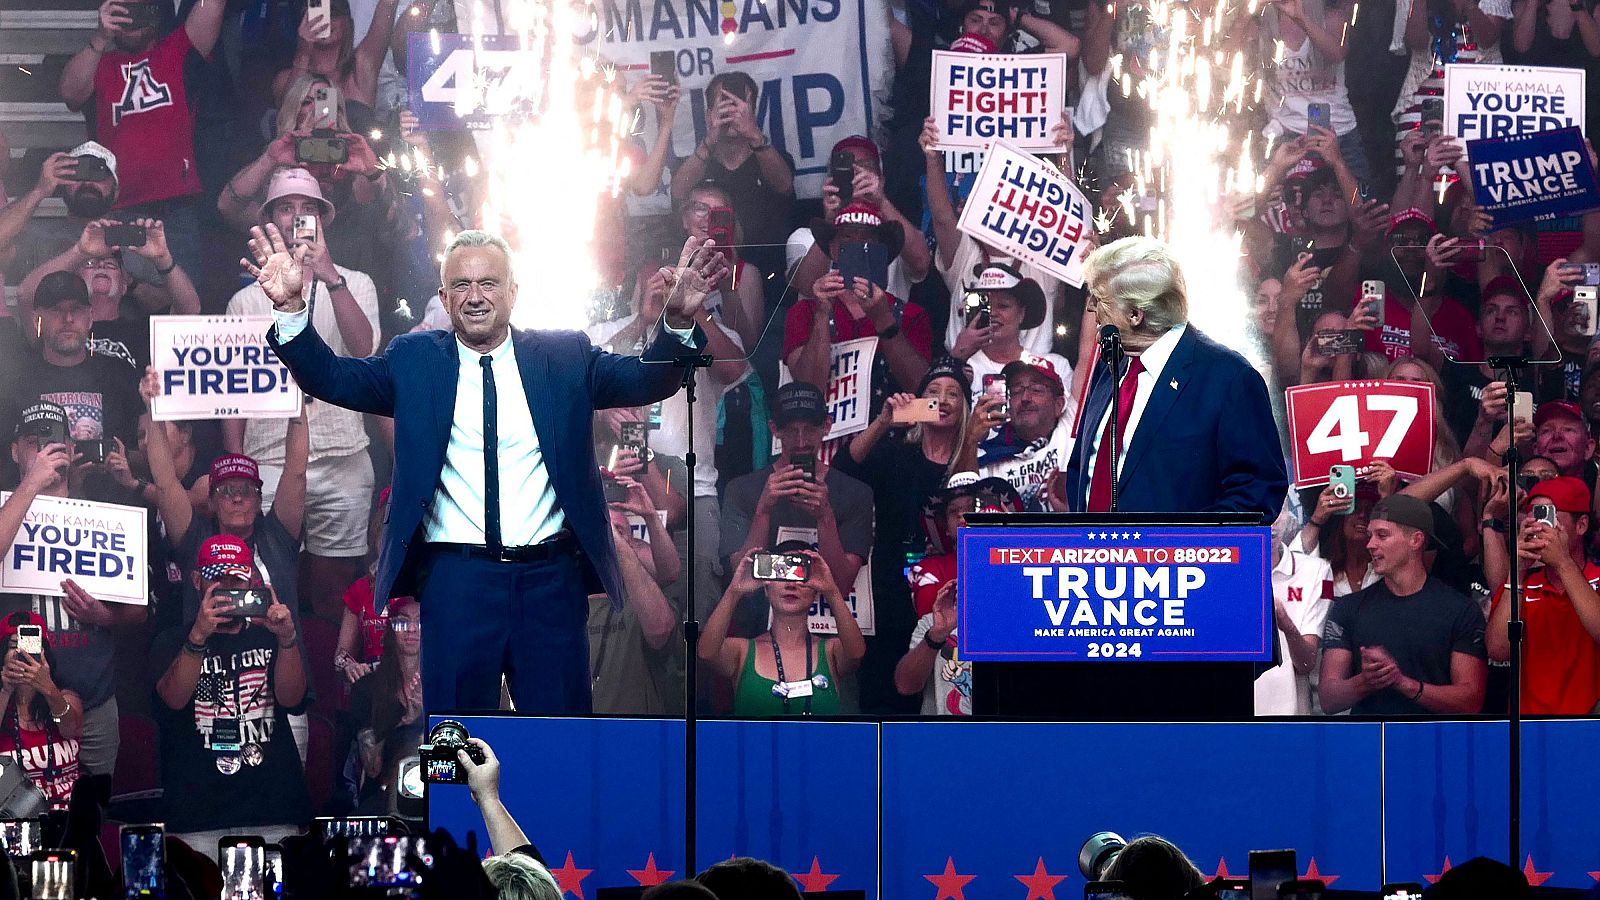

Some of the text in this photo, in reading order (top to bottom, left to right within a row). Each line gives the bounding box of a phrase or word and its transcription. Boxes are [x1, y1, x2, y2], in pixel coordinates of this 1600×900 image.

[949, 65, 1047, 89] FIGHT!
[1467, 80, 1564, 94] LYIN' KAMALA
[948, 89, 1047, 114] FIGHT!
[1466, 92, 1565, 114] YOU'RE
[947, 113, 1047, 138] FIGHT!
[1475, 151, 1582, 187] TRUMP
[1000, 159, 1084, 222] FIGHT!
[1488, 173, 1578, 203] VANCE
[1508, 197, 1538, 208] AMERICA
[1540, 192, 1562, 202] GREAT
[834, 212, 881, 226] TRUMP
[991, 182, 1083, 244] FIGHT!
[1534, 212, 1556, 222] 2024
[981, 205, 1075, 267] FIGHT!
[173, 333, 208, 345] LYIN'
[172, 345, 280, 367] YOU'RE
[164, 367, 289, 396] FIRED!
[22, 405, 39, 416] MAKE
[24, 412, 44, 423] GREAT
[214, 408, 239, 416] 2024
[1306, 394, 1418, 462] 47
[23, 512, 125, 532] LYIN' KAMALA
[22, 522, 126, 552] YOU'RE
[210, 543, 242, 553] Trump
[13, 543, 135, 581] FIRED!
[997, 549, 1232, 564] TEXT ARIZONA TO 88022
[1023, 566, 1207, 599] TRUMP
[1288, 587, 1303, 601] N
[1043, 599, 1185, 626] VANCE
[811, 622, 829, 630] 2024
[1034, 628, 1195, 637] MAKE AMERICA GREAT AGAIN!
[1087, 642, 1142, 658] 2024
